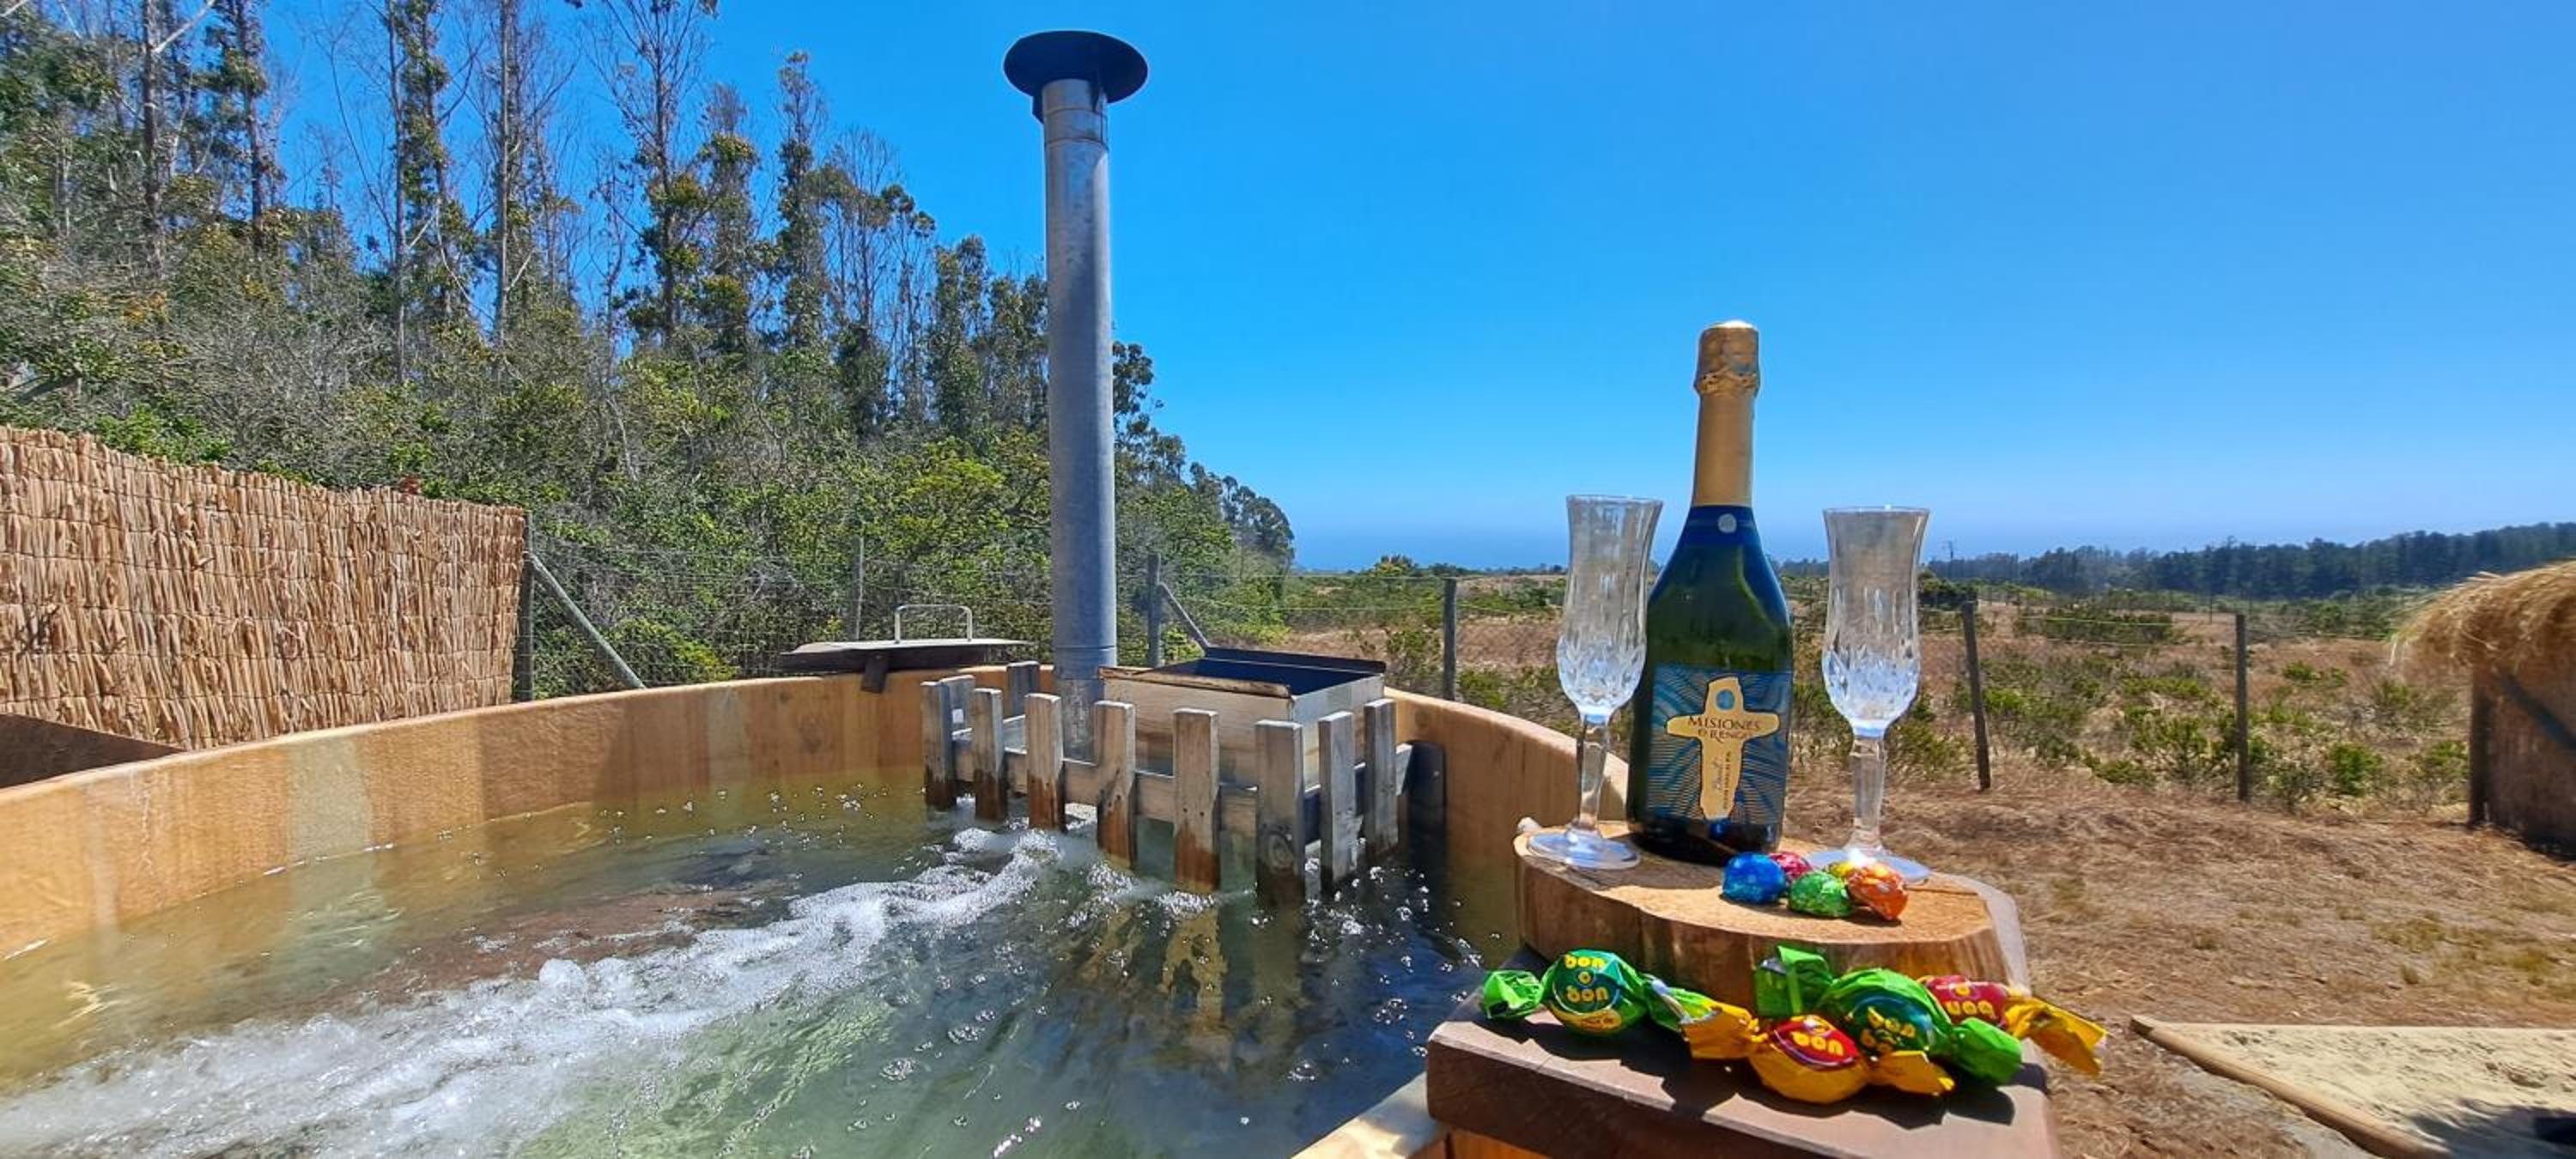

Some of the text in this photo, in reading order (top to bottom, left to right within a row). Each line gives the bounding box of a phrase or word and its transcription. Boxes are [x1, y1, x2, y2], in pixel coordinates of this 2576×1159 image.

[1688, 715, 1759, 731] MISIONES
[1564, 954, 1605, 969] bon
[1566, 985, 1608, 1003] bon
[1789, 1031, 1844, 1057] bon
